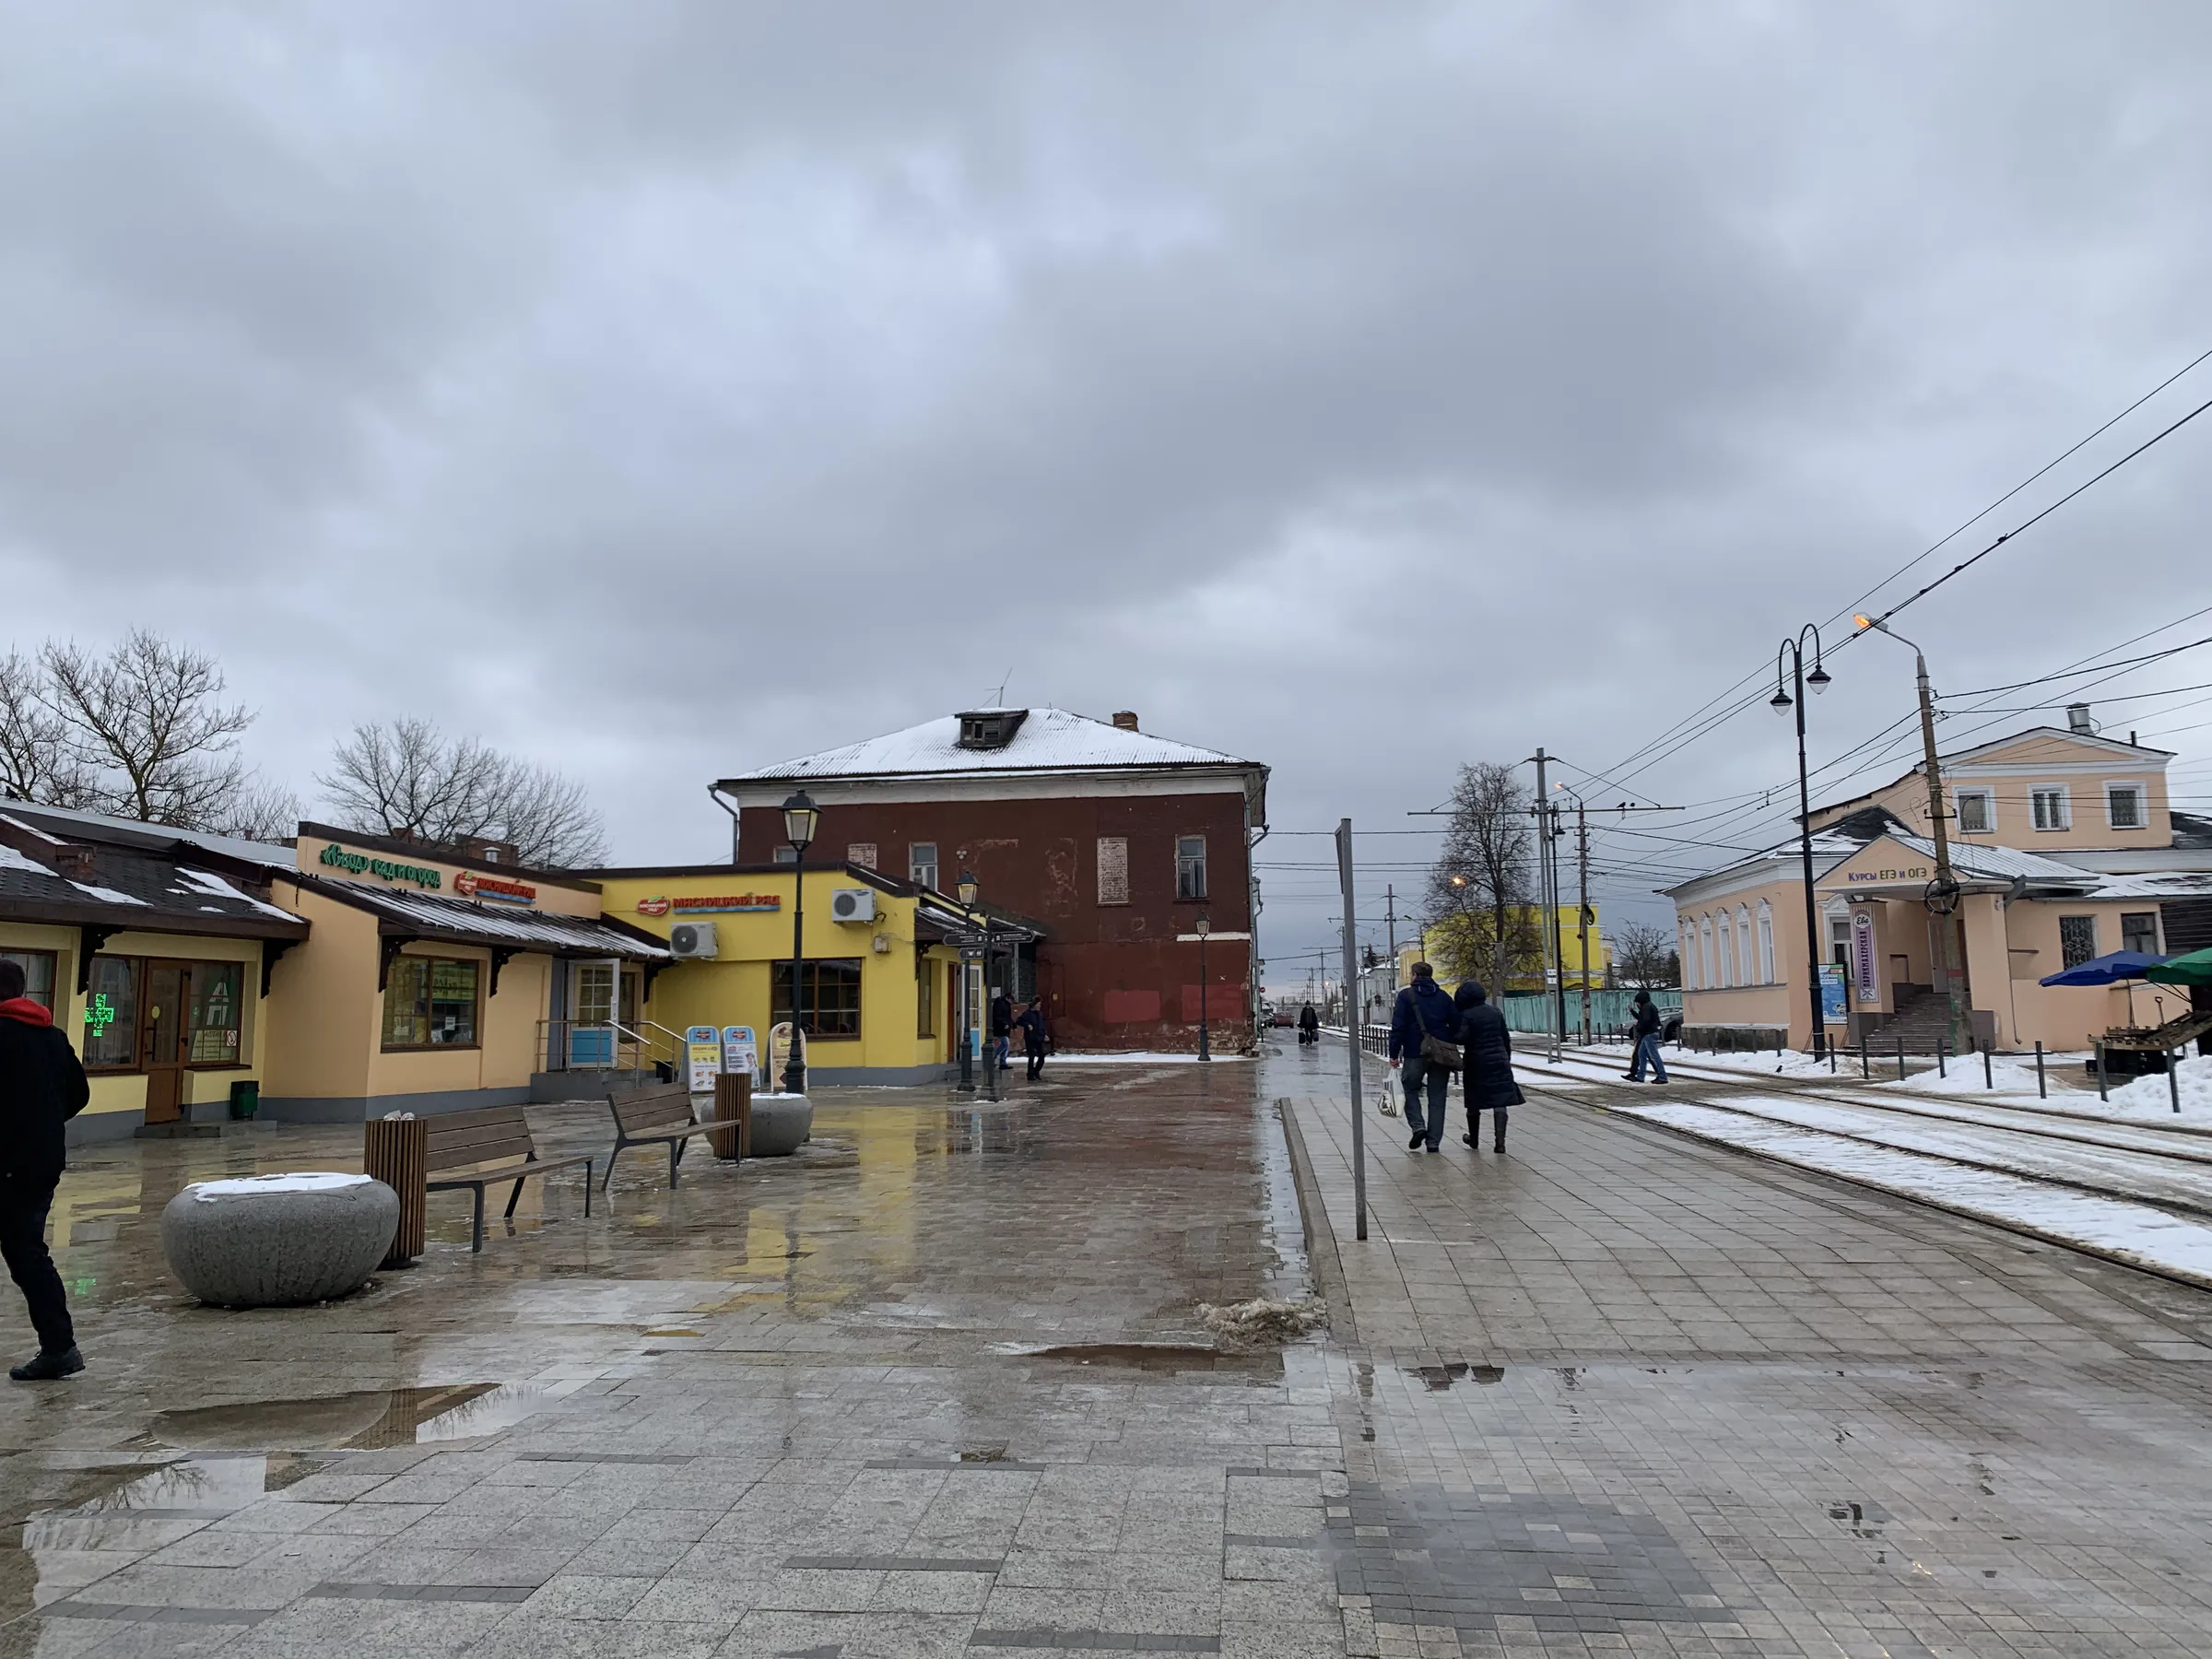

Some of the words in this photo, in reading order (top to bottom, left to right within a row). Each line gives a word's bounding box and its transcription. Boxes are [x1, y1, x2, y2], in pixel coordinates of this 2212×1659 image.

[1880, 869, 1897, 880] ЕГЭ
[1908, 867, 1927, 878] ОГЭ
[672, 896, 752, 908] МЯСНИЦКИЙ
[754, 895, 781, 905] РЯД
[1856, 916, 1870, 924] Ева
[1859, 931, 1871, 987] ПАРИКМАХЕРСКАЯ
